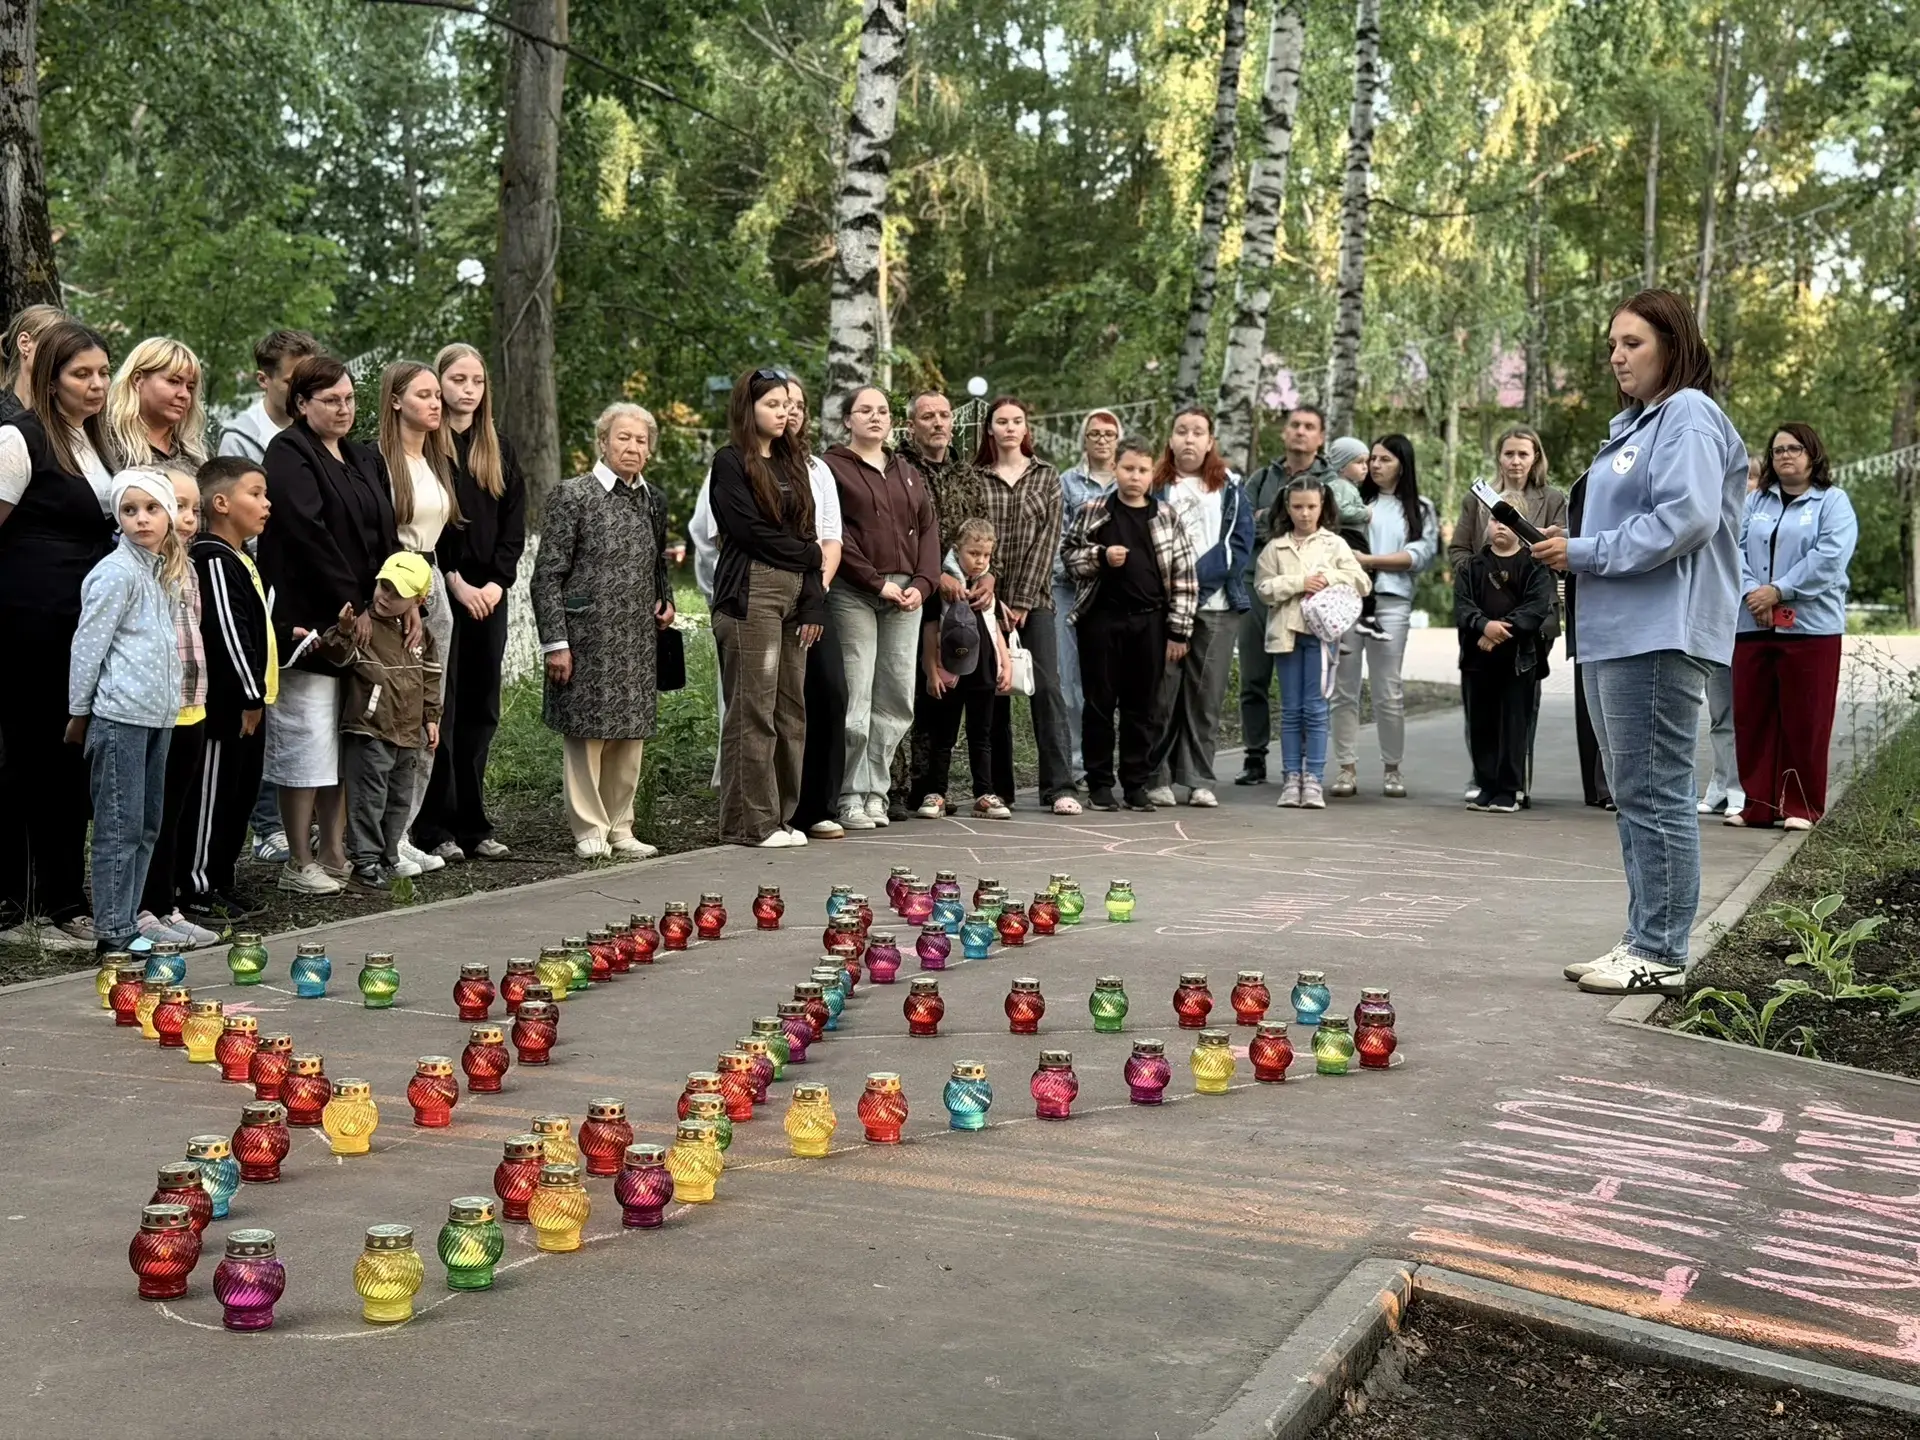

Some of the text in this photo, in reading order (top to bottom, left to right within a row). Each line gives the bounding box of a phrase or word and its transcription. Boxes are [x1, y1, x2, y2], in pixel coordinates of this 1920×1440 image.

[1154, 890, 1350, 937] ПАМЯТЬ
[1292, 891, 1481, 942] ВЕЧНАЯ
[1408, 1074, 1783, 1308] ПОМНИТ
